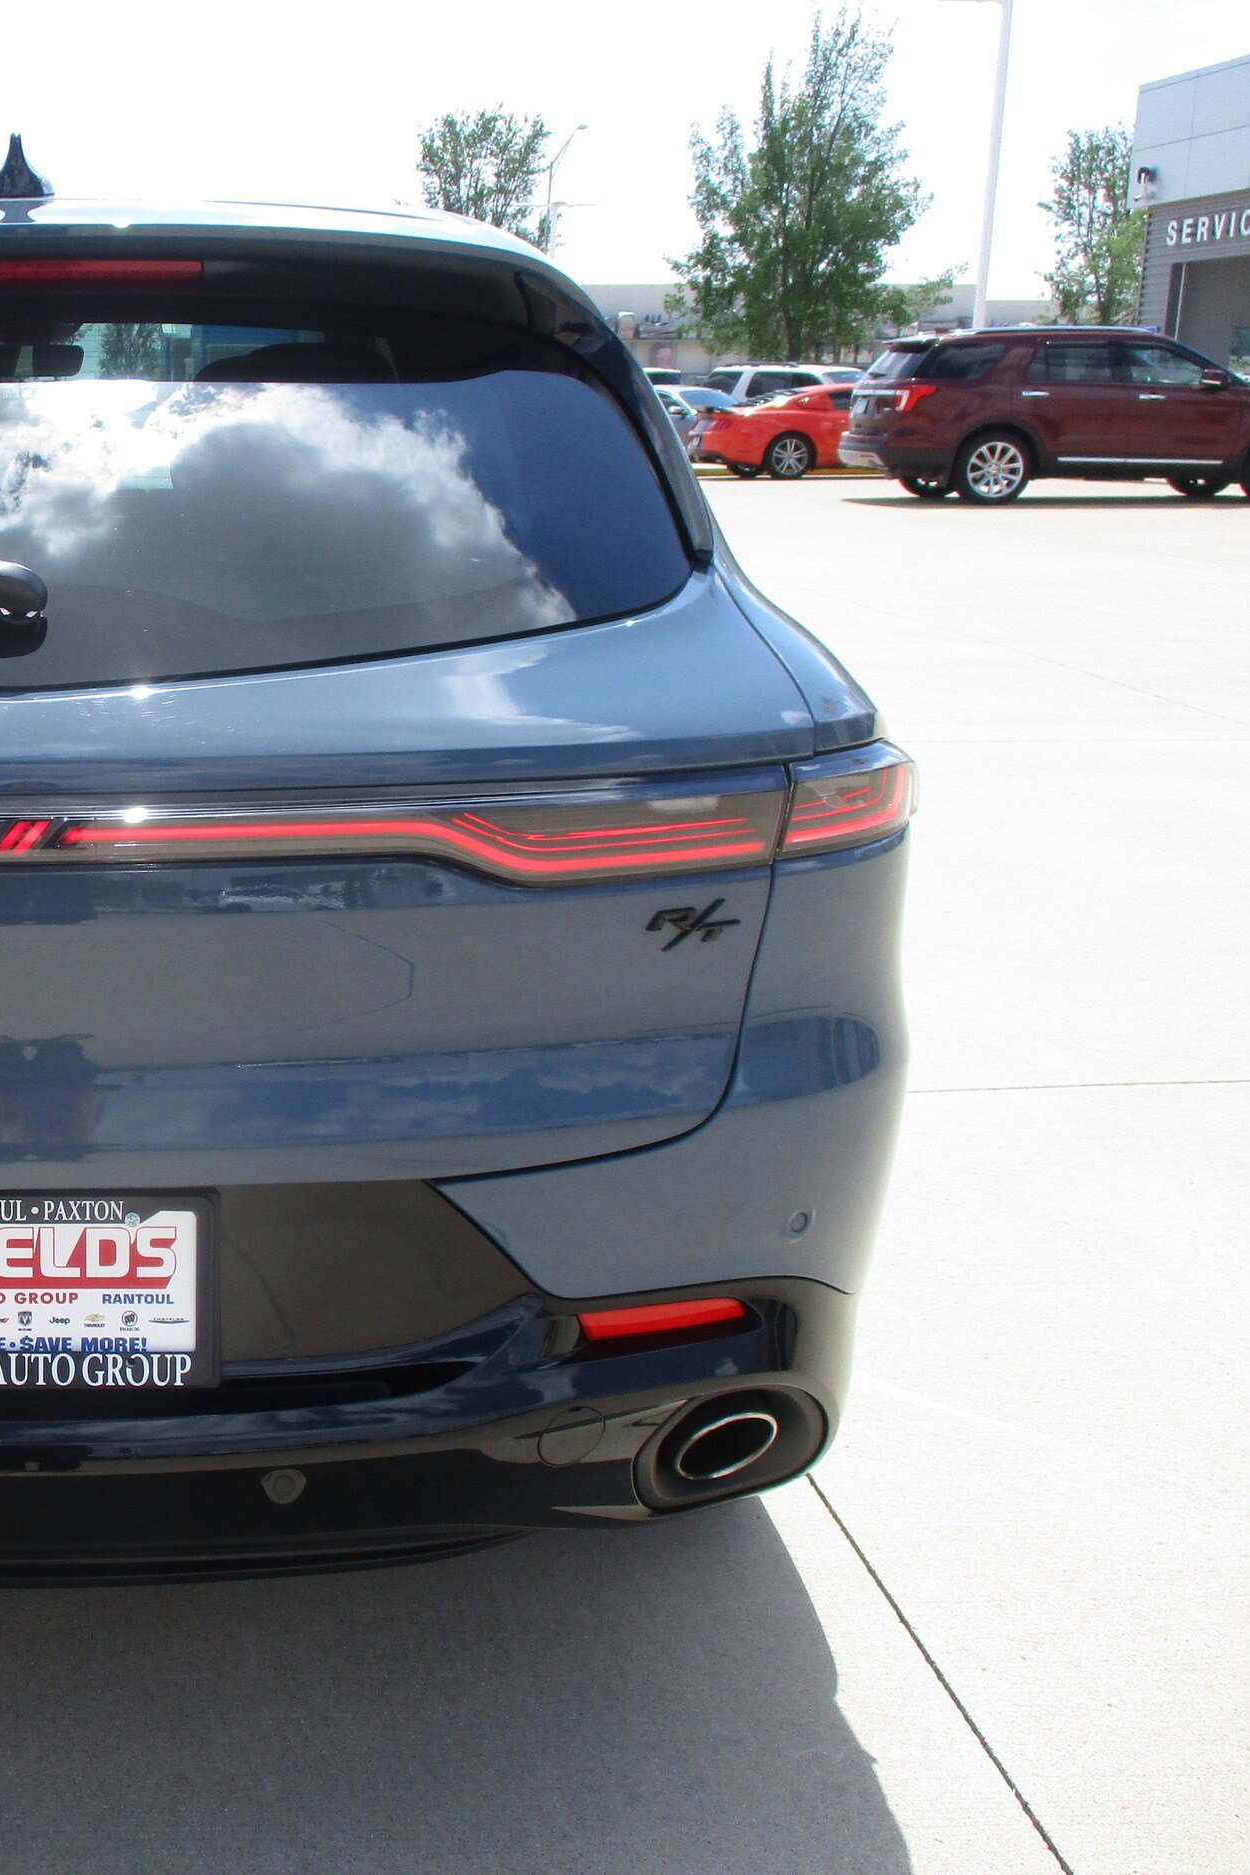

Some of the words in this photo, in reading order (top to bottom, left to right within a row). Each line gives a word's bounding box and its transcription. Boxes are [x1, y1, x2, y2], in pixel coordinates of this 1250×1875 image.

[43, 1200, 124, 1222] PAXTON
[14, 1292, 79, 1305] GROUP
[101, 1293, 175, 1305] RANTOUL
[49, 1316, 71, 1325] Jeep
[81, 1337, 147, 1351] MORE!
[82, 1353, 192, 1387] GROUP
